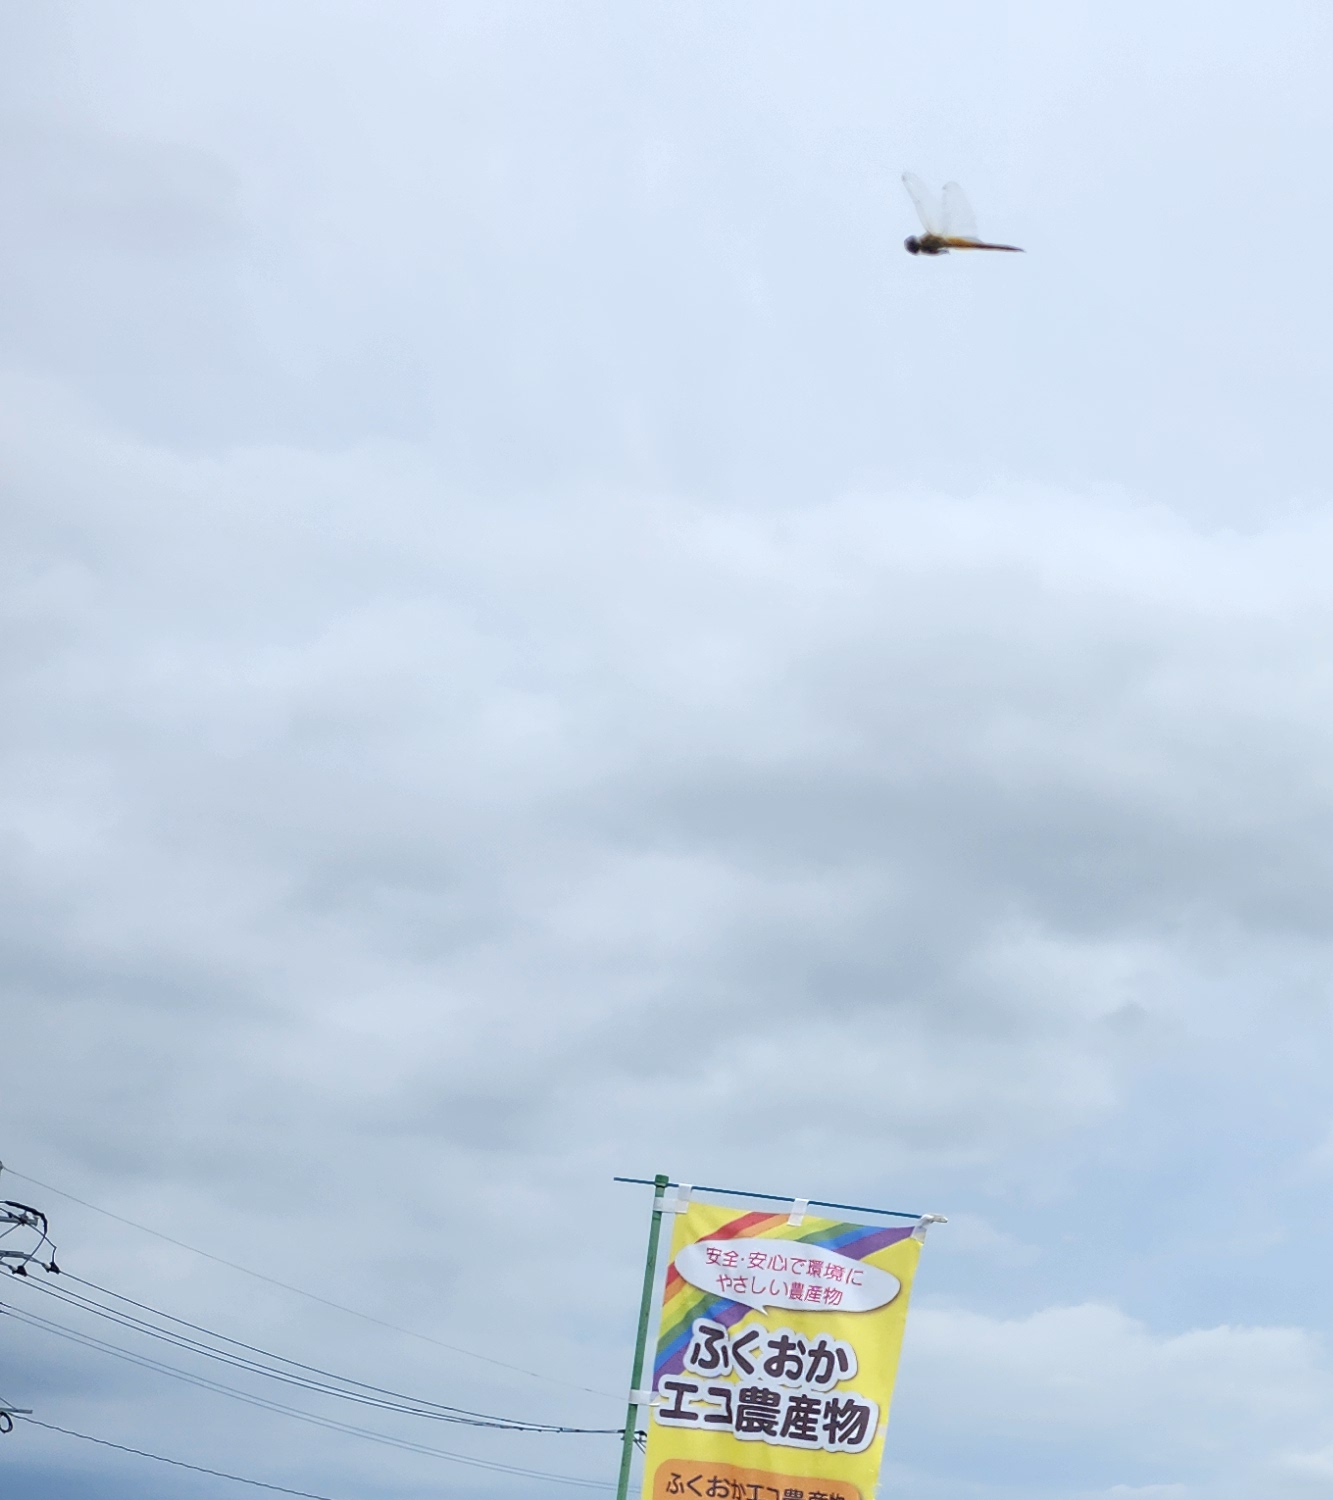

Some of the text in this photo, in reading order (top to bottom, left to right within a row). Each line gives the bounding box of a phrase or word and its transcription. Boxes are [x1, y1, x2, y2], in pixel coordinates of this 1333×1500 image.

[715, 1273, 844, 1306] やさしい農産物
[690, 1325, 850, 1384] ふくおか
[659, 1380, 871, 1445] エコ農産物
